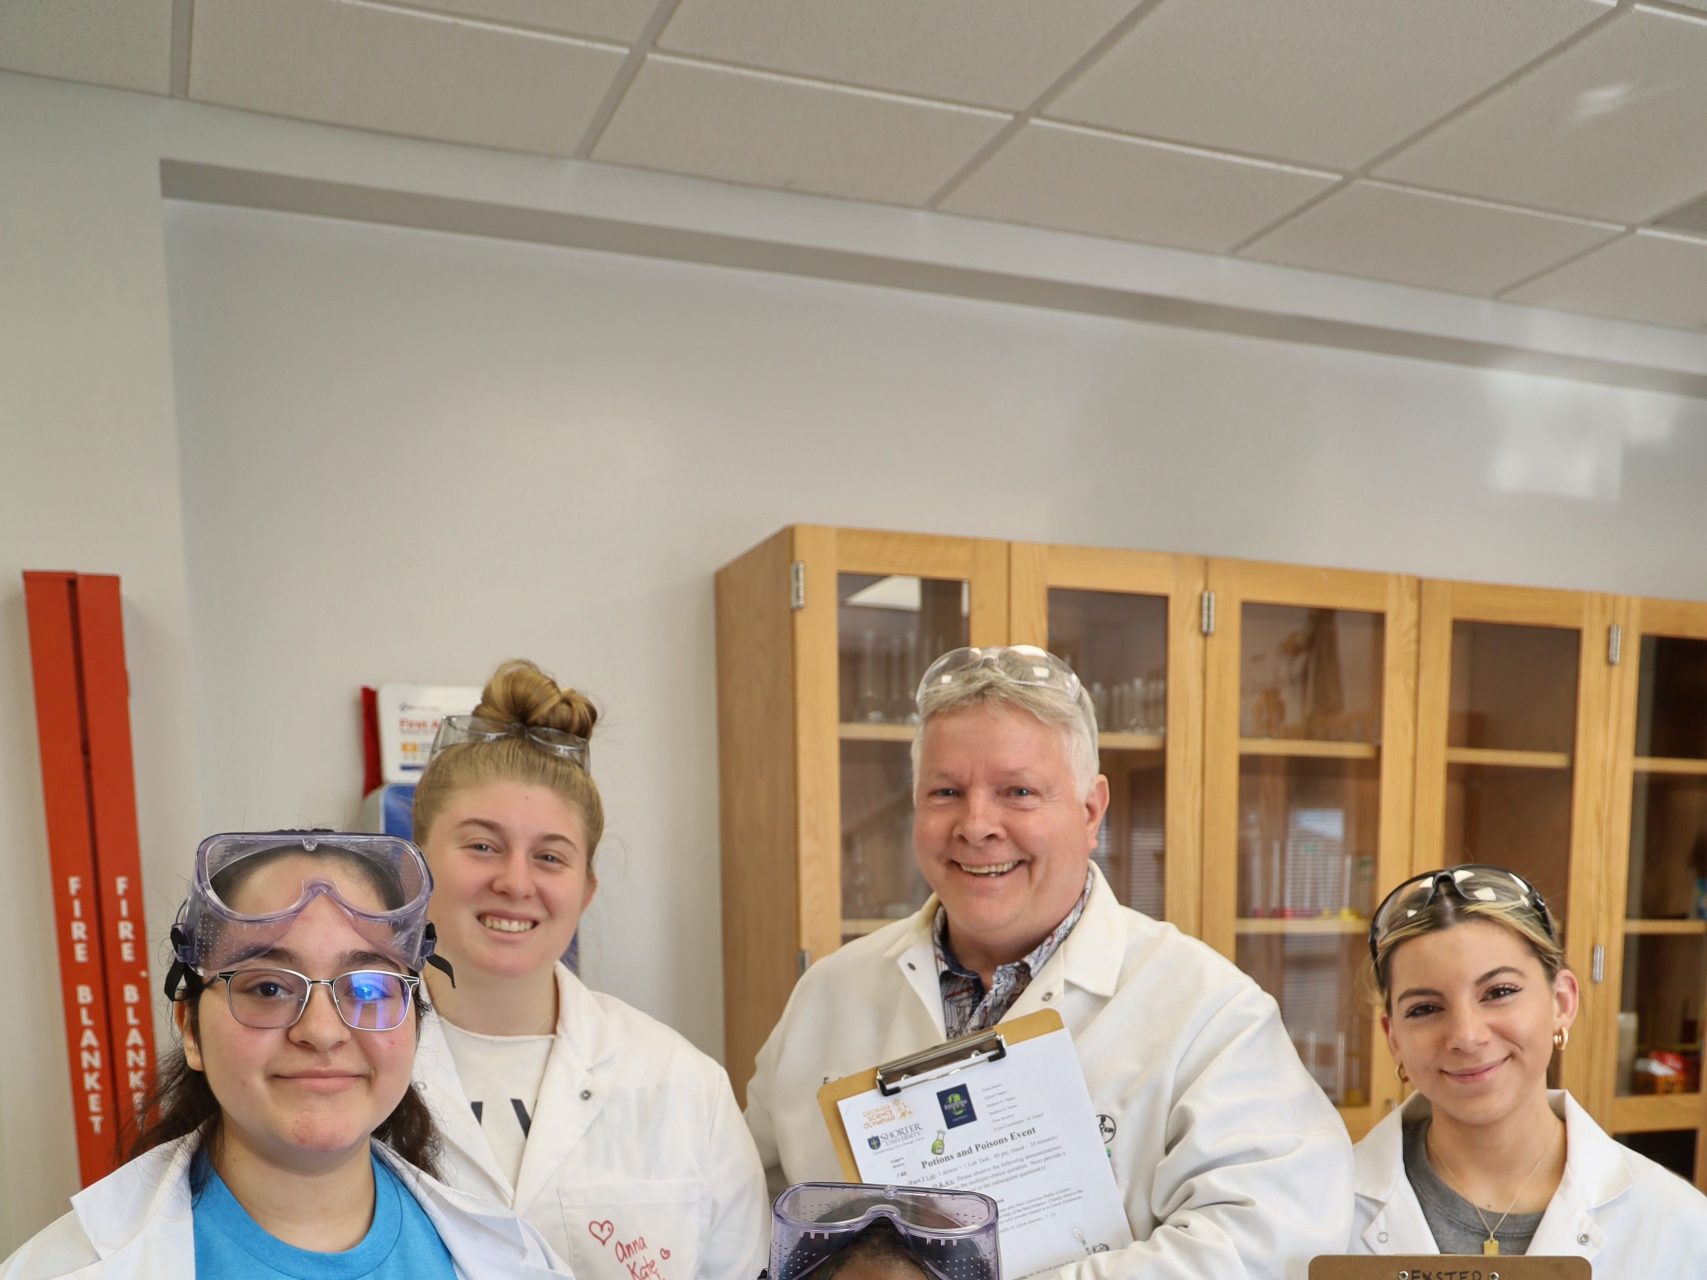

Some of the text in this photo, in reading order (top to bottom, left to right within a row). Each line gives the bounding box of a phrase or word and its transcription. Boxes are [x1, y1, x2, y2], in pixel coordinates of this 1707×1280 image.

[115, 876, 135, 962] FIRE
[68, 876, 104, 1134] FIRE BLANKET
[880, 1124, 922, 1141] SHORTER
[922, 1127, 1036, 1168] Potions and Poisons Event
